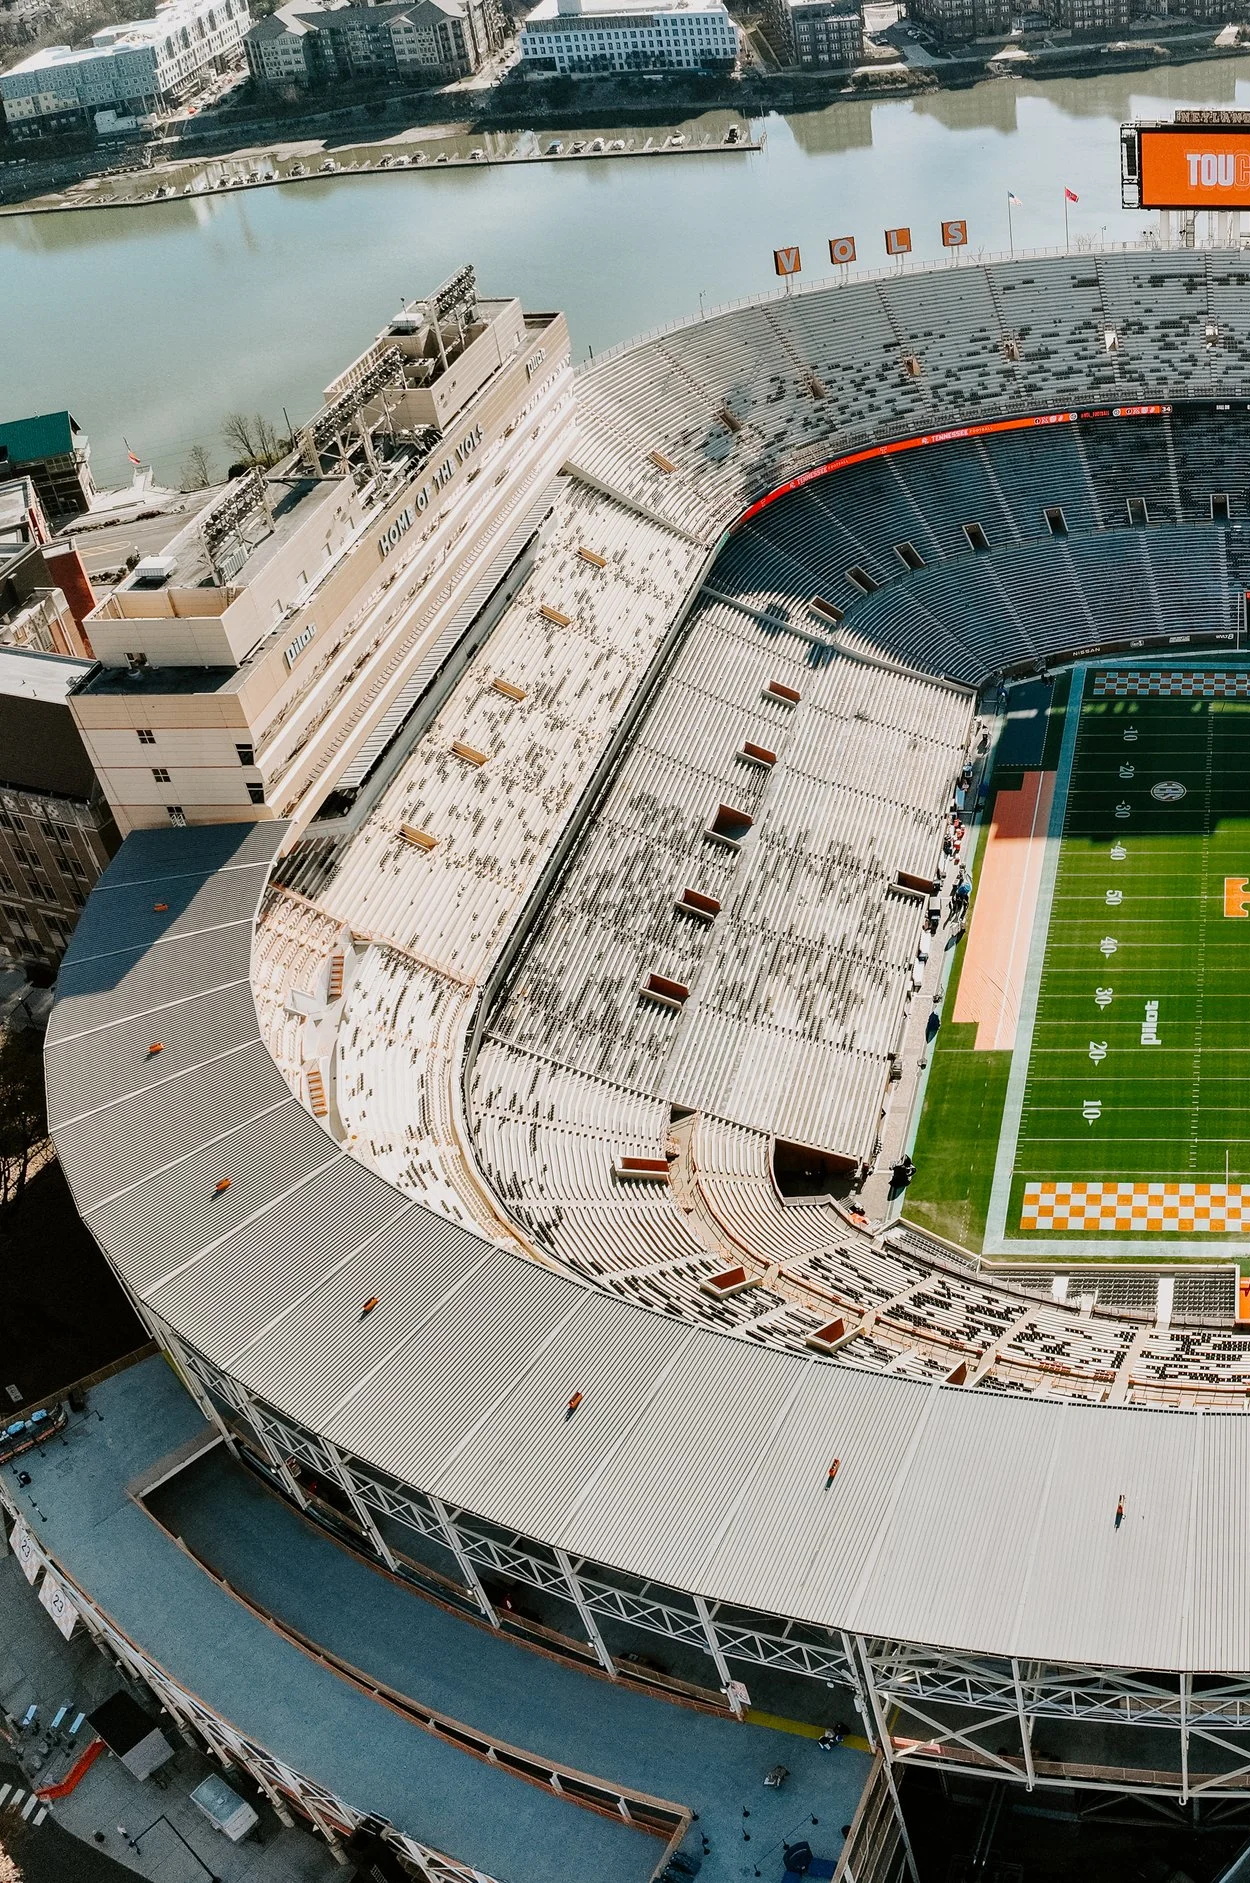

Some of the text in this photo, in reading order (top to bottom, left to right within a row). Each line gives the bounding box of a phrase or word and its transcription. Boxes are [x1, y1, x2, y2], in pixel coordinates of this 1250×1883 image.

[931, 428, 969, 443] TENNESSEE
[379, 507, 417, 557] HOME
[415, 485, 432, 512] OF
[434, 460, 456, 492] THE
[284, 620, 317, 667] pilot
[1072, 647, 1101, 657] NISSAN
[1123, 729, 1138, 742] 10
[1119, 765, 1135, 779] 20
[1115, 804, 1131, 818] 30
[1110, 845, 1127, 861] 40
[1105, 889, 1123, 906] 50
[1100, 936, 1118, 954] 40
[1094, 987, 1113, 1005] 30
[1088, 1040, 1108, 1060] 20
[1082, 1099, 1102, 1120] 10
[21, 1539, 31, 1558] 23
[53, 1594, 64, 1613] 23
